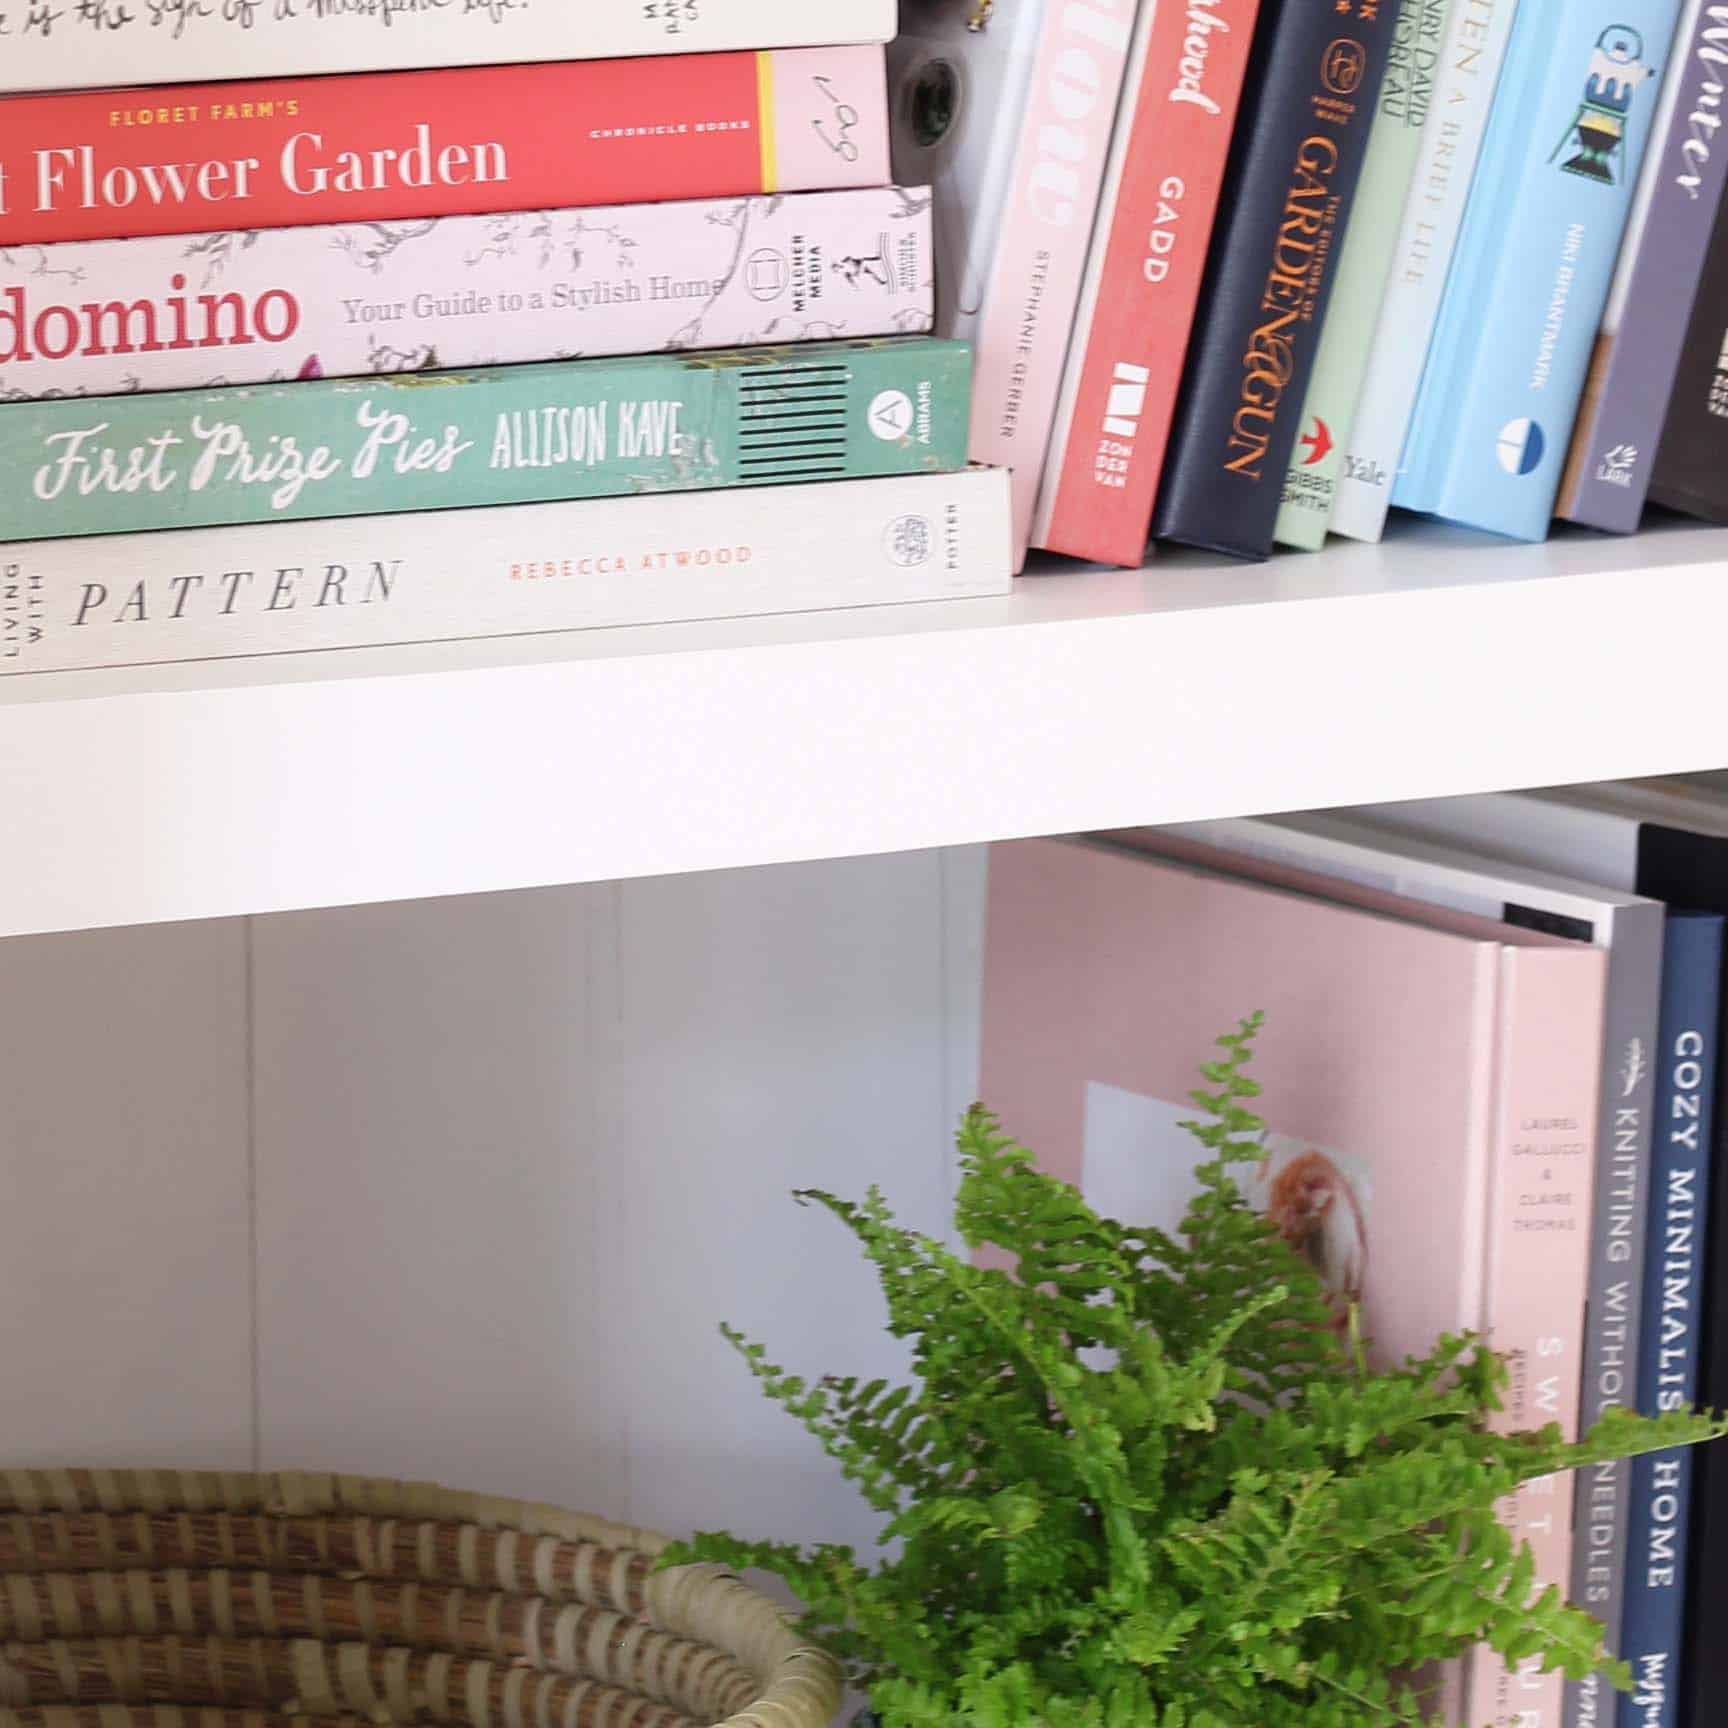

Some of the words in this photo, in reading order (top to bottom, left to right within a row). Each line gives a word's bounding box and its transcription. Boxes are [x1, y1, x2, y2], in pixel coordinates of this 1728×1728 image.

[109, 106, 200, 127] FLORET
[210, 99, 299, 121] FARM'S
[1408, 47, 1437, 128] DAVID
[32, 145, 260, 212] Flower
[281, 125, 509, 195] Garden
[1144, 175, 1185, 283] GADD
[343, 296, 404, 325] Your
[413, 288, 492, 320] Guide
[497, 291, 523, 312] to
[527, 293, 544, 310] a
[551, 280, 643, 312] Stylish
[648, 276, 727, 301] Home
[791, 235, 805, 312] MELCHER
[809, 245, 820, 299] MEDIA
[1017, 249, 1051, 353] STEPHANIE
[489, 402, 606, 469] ALLISON
[917, 381, 932, 444] ABRAMS
[999, 362, 1028, 439] GERBER
[33, 423, 178, 500] First
[189, 415, 340, 509] Prize
[351, 400, 474, 479] Pies
[1345, 454, 1385, 485] Yale
[28, 575, 44, 643] WITH
[72, 560, 403, 627] PATTERN
[511, 557, 627, 580] REBECCA
[642, 548, 752, 569] ATWOOD
[3, 563, 20, 657] LIVING
[1671, 1029, 1702, 1151] COZY
[1605, 1108, 1640, 1265] KNITTING
[1585, 1459, 1616, 1603] NEEDLES
[1648, 1460, 1680, 1589] HOME
